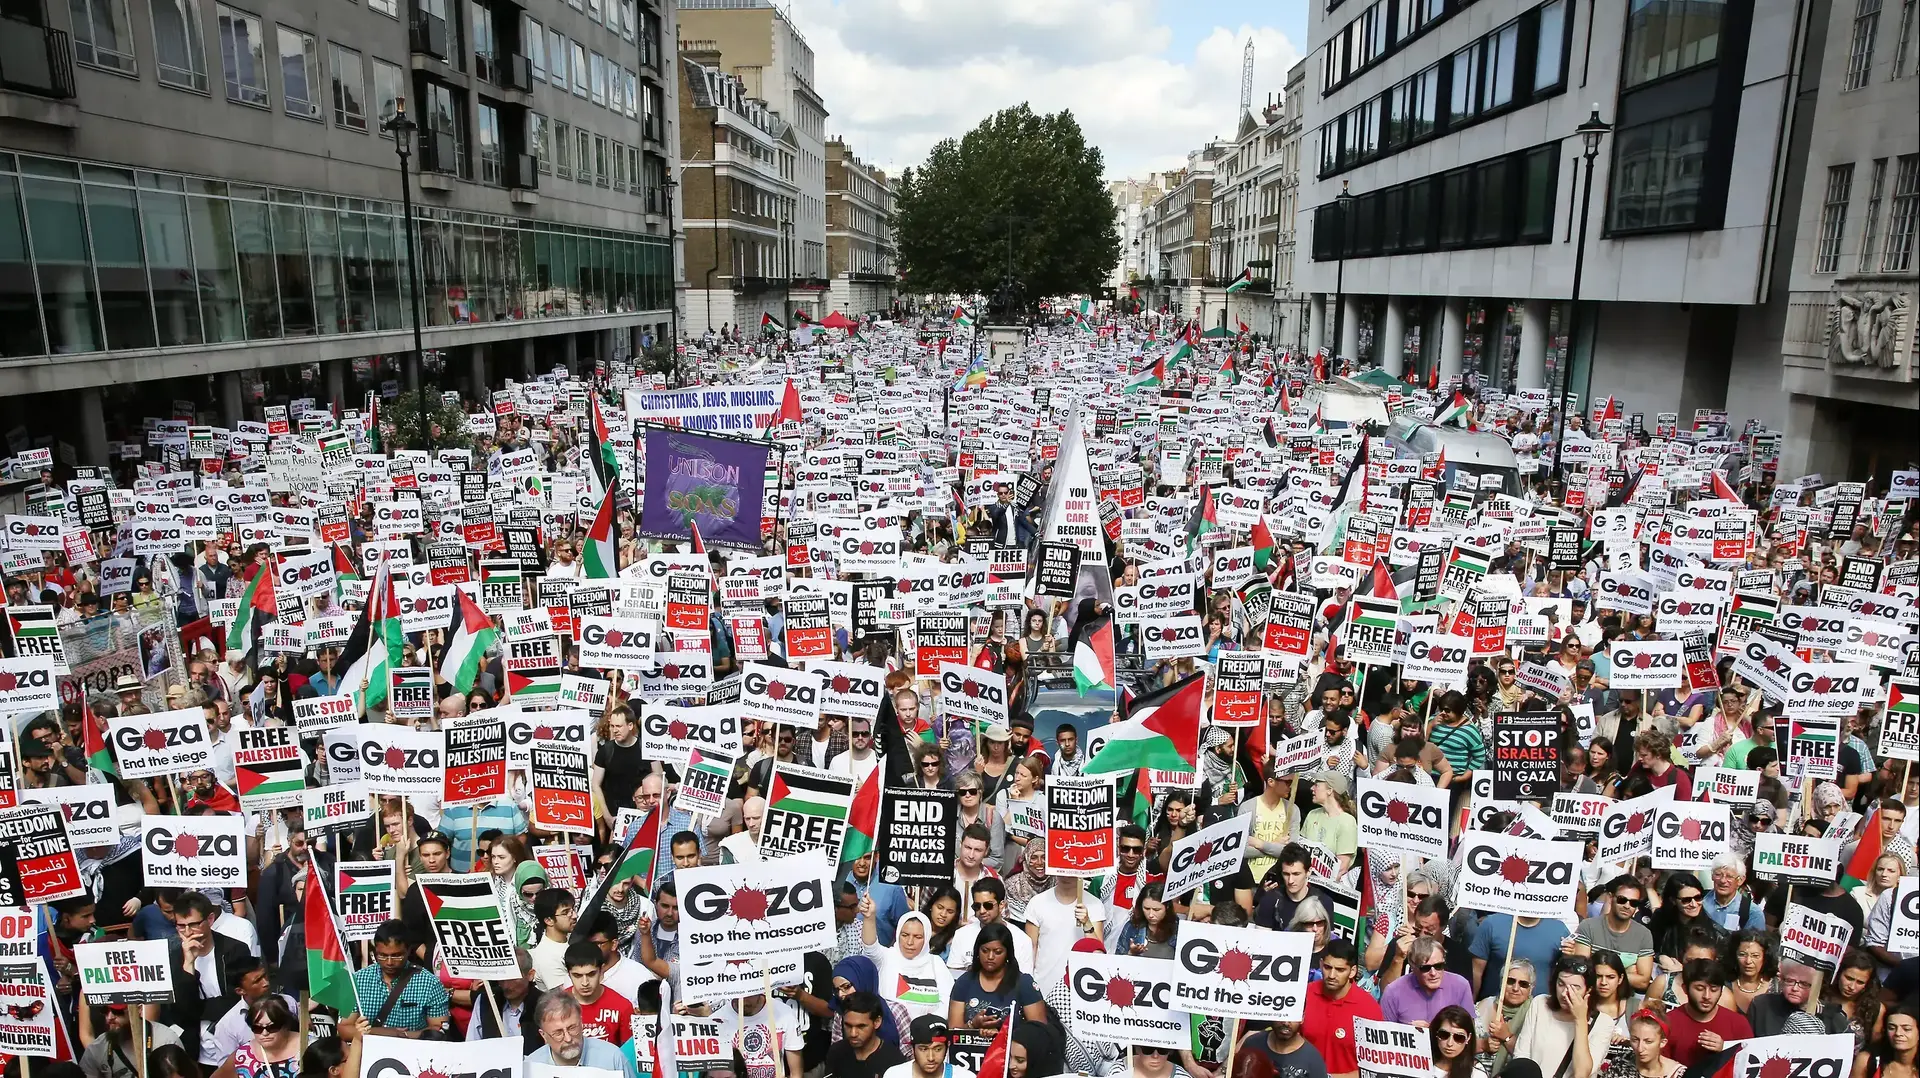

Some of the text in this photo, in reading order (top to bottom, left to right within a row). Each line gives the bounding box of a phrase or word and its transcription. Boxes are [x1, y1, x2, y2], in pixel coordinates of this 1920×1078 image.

[641, 393, 700, 410] CHRISTIANS,
[703, 392, 729, 408] JEWS,
[683, 415, 717, 430] KNOWS
[720, 415, 742, 429] THIS
[744, 414, 752, 428] IS
[1070, 488, 1087, 497] YOU
[82, 496, 103, 505] END
[1065, 501, 1090, 510] DON'T
[1488, 501, 1510, 511] FREE
[1066, 514, 1088, 522] CARE
[10, 522, 59, 536] Gza
[1057, 526, 1096, 535] BECAUSE
[1556, 533, 1578, 542] END
[1046, 547, 1071, 561] END
[4, 557, 41, 567] PALESTINE
[1848, 561, 1875, 575] END
[1042, 568, 1070, 578] ATTACKS
[725, 580, 739, 588] STOP
[1052, 576, 1070, 585] GAZA
[483, 583, 520, 597] FREE
[727, 587, 759, 597] KILLING
[987, 592, 1020, 601] PALESTINE
[788, 600, 825, 612] FREEDOM
[1170, 599, 1190, 608] siege
[738, 619, 755, 628] STOP
[787, 617, 828, 628] PALESTINE
[1350, 626, 1394, 643] FREE
[512, 642, 552, 657] FREE
[1348, 639, 1391, 652] PALESTINE
[508, 656, 557, 669] PALESTINE
[1788, 699, 1854, 709] End the siege
[240, 728, 290, 749] FREE
[450, 727, 501, 744] FREEDOM
[1287, 735, 1318, 752] END THE
[1791, 741, 1834, 758] FREE
[236, 746, 298, 763] PALESTINE
[447, 749, 504, 767] PALESTINE
[1498, 747, 1556, 759] ISRAEL'S
[1498, 761, 1556, 769] WAR CRIMES
[685, 768, 727, 795] FREE
[1498, 771, 1556, 782] IN GAZA
[682, 786, 722, 802] PALESTINE
[1053, 787, 1107, 806] FREEDOM
[895, 801, 943, 822] END
[1077, 806, 1086, 814] for
[1050, 812, 1111, 830] PALESTINE
[890, 825, 946, 837] ISRAEL'S
[146, 828, 238, 857] Gza
[889, 838, 945, 850] ATTACKS
[1782, 842, 1809, 854] FREE
[889, 851, 945, 864] ON GAZA
[1759, 852, 1832, 871] PALESTINE
[148, 864, 239, 879] End the siege
[1466, 844, 1572, 887] Gza
[1465, 882, 1569, 903] Stop the massacre
[684, 878, 824, 922] Gza
[434, 920, 508, 946] FREE
[690, 921, 826, 944] Stop the massacre
[105, 951, 136, 965] FREE
[443, 946, 512, 959] PALESTINE
[1180, 939, 1301, 982] Gza
[84, 965, 165, 983] PALESTINE
[1177, 982, 1296, 1011] End the siege
[596, 1008, 619, 1023] JPN
[1366, 1027, 1416, 1049] END THE
[1359, 1046, 1430, 1070] OCCUPATION
